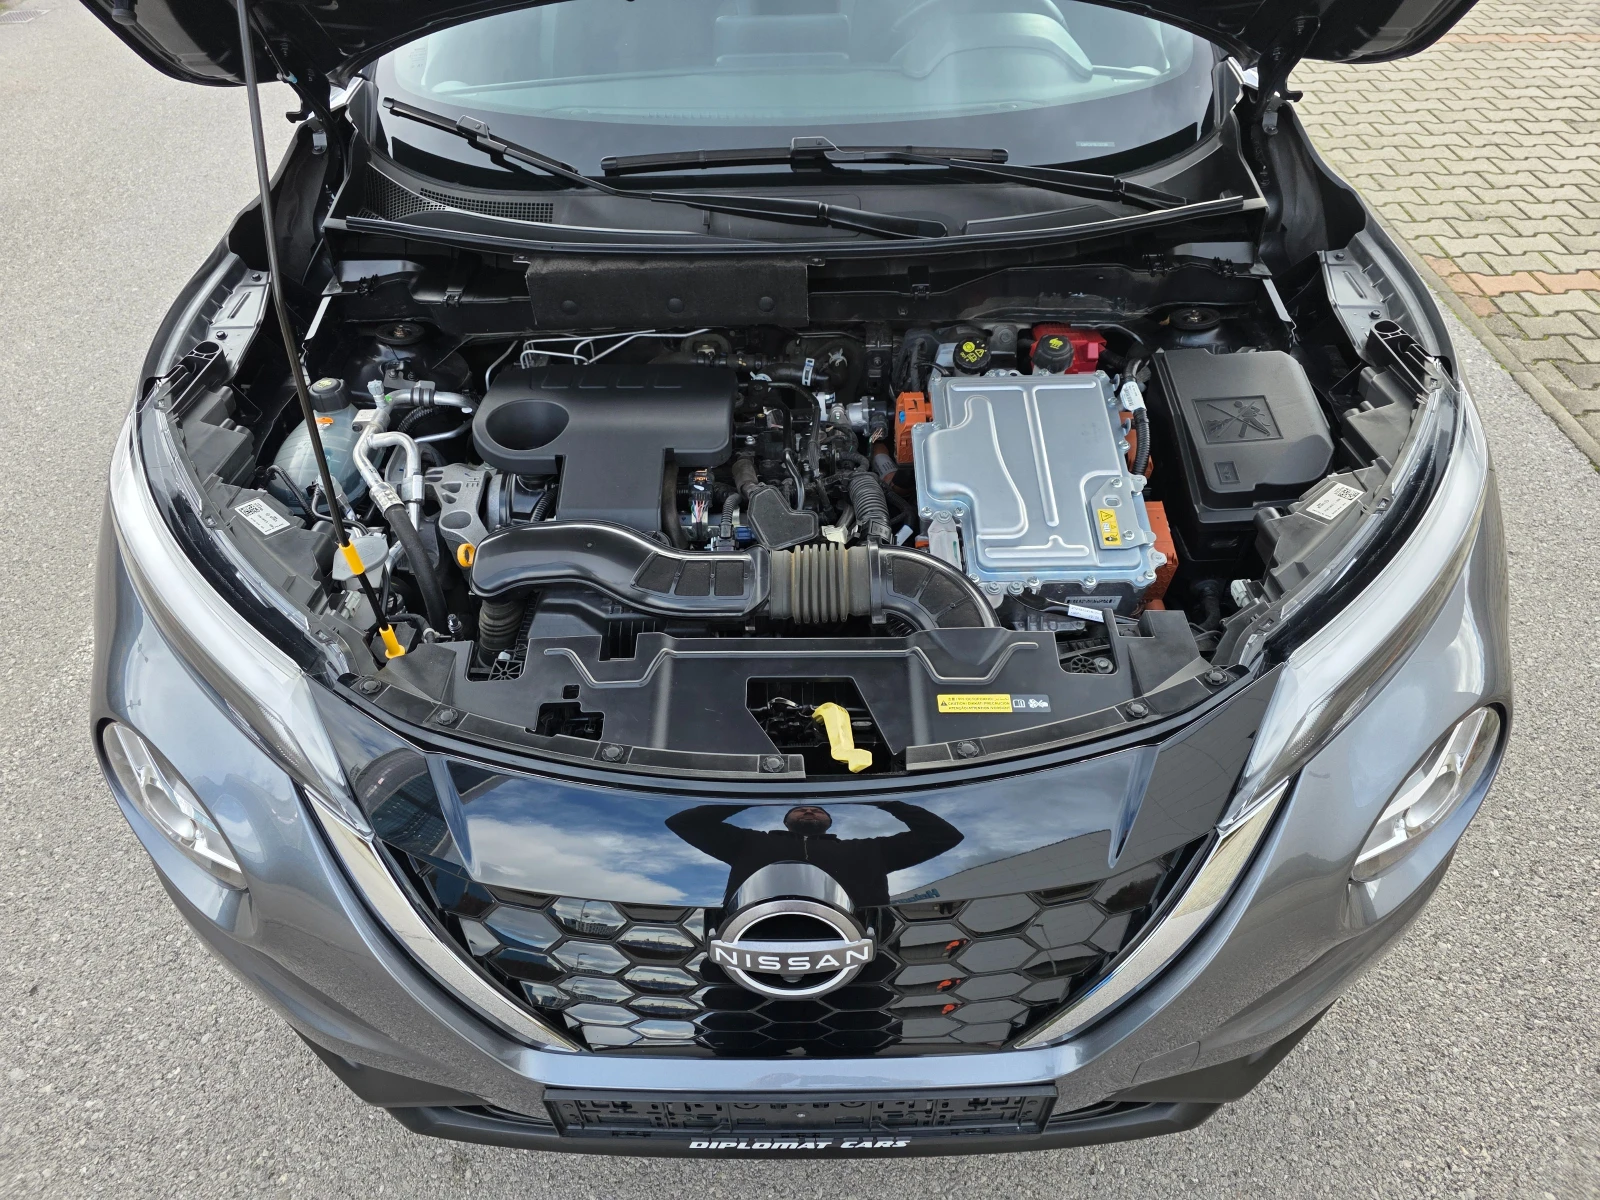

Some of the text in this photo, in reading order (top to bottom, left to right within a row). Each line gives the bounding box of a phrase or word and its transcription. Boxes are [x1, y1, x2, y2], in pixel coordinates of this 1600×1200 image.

[715, 946, 869, 971] NISSAN
[688, 1140, 911, 1150] DIPLOMAT CARS
